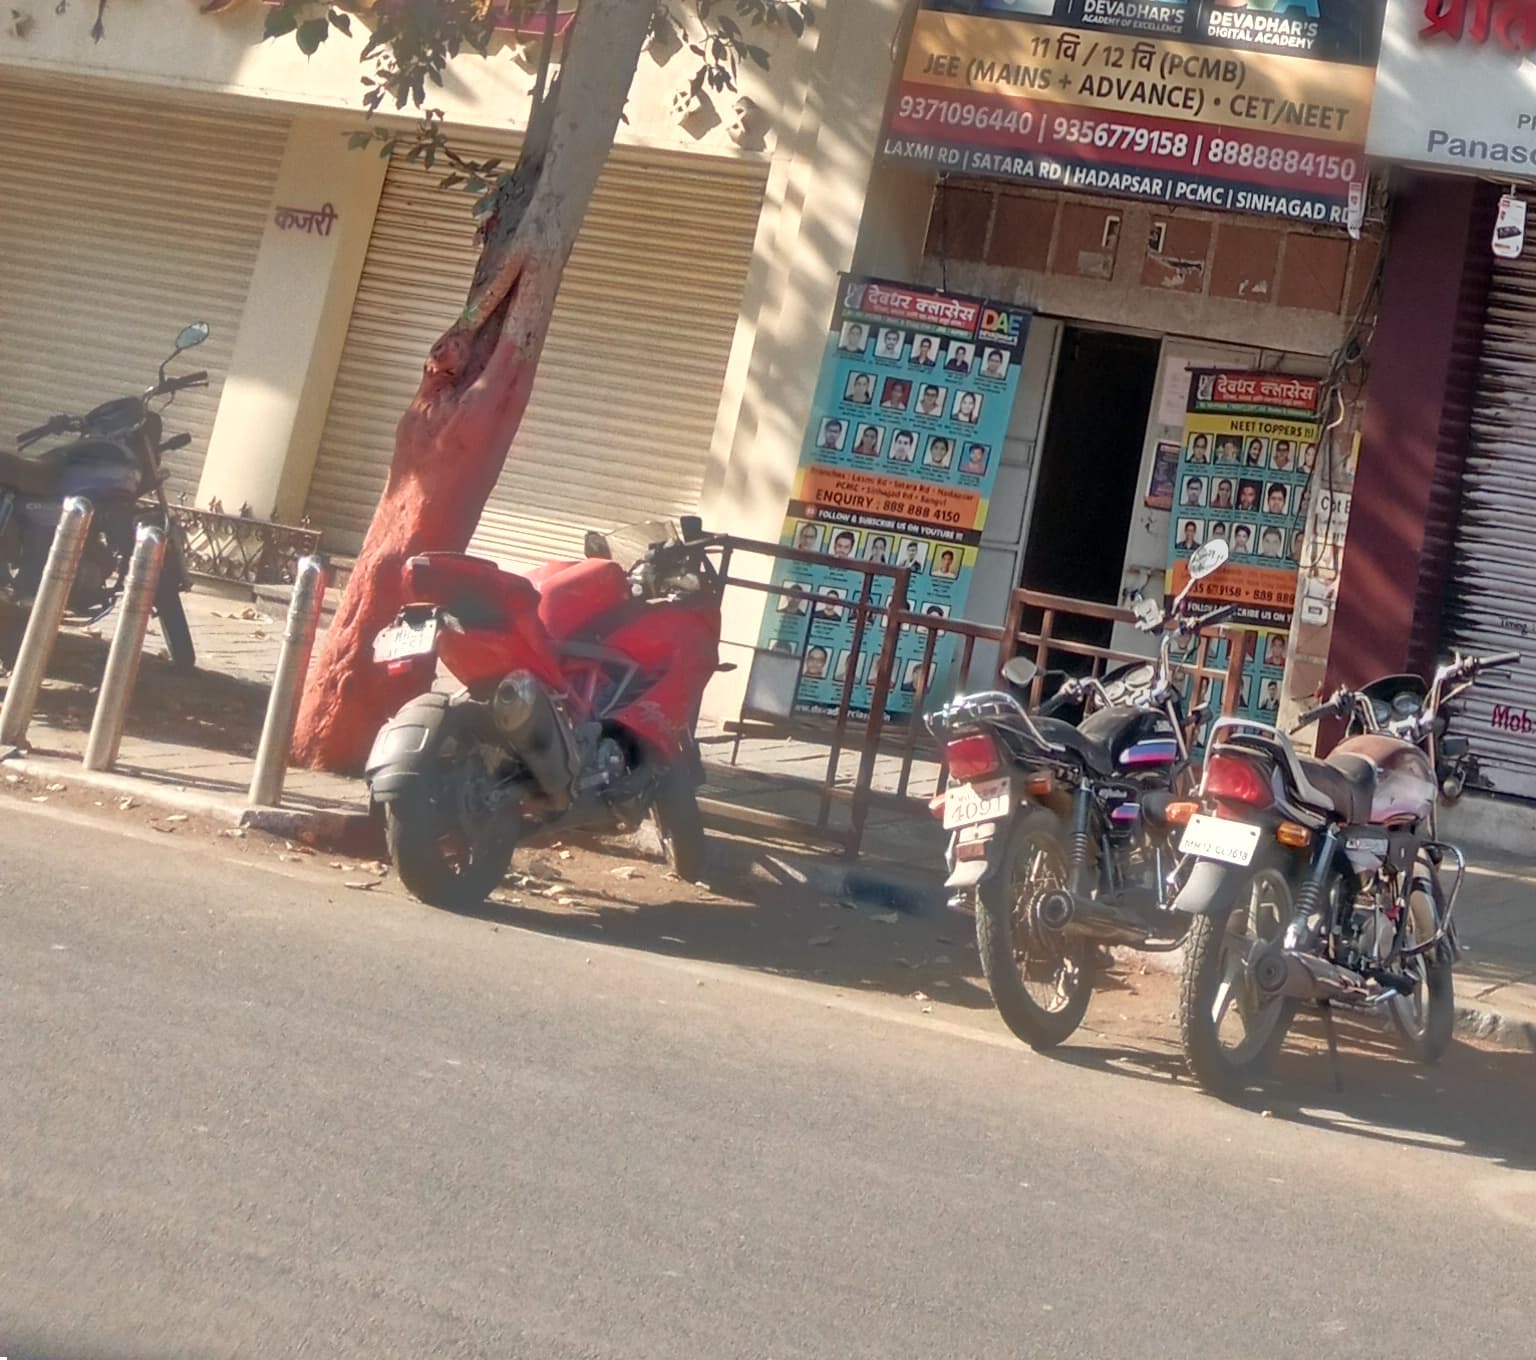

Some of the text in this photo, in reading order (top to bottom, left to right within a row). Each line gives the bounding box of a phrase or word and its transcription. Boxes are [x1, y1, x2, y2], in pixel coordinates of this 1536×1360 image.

[1208, 26, 1315, 50] DIGITAL ACADEMY
[1209, 10, 1319, 38] DEVADHAR'S
[1102, 46, 1125, 68] 12
[1160, 51, 1247, 90] (PCMB)
[923, 53, 961, 77] JEE
[966, 57, 1052, 90] (MAINS
[1078, 74, 1205, 116] ADVANCE)
[1229, 93, 1350, 131] CET/NEET
[899, 95, 1356, 181] 9371096440 9356779158 8888884150
[883, 139, 935, 158] LAXMI
[937, 147, 960, 165] RD
[971, 152, 1035, 177] SATARA
[1039, 162, 1062, 180] RD
[1073, 167, 1163, 195] HADAPSAR
[1175, 181, 1225, 204] PCMC
[1236, 191, 1326, 220] SINHAGAD
[275, 202, 338, 236] कजरी
[867, 285, 913, 310] देवधर
[915, 294, 976, 321] क्लासेस
[982, 308, 1024, 335] DAE
[1217, 374, 1257, 394] देवधर
[1260, 380, 1315, 400] क्लासेस
[1230, 420, 1302, 437] NEET TOPPERS
[816, 489, 873, 509] ENQUIRY
[907, 502, 929, 518] 888
[933, 508, 960, 523] 4150
[818, 509, 851, 523] FOLLOW
[858, 515, 895, 528] SUBSCRIBE
[920, 524, 954, 539] YOUTUBE
